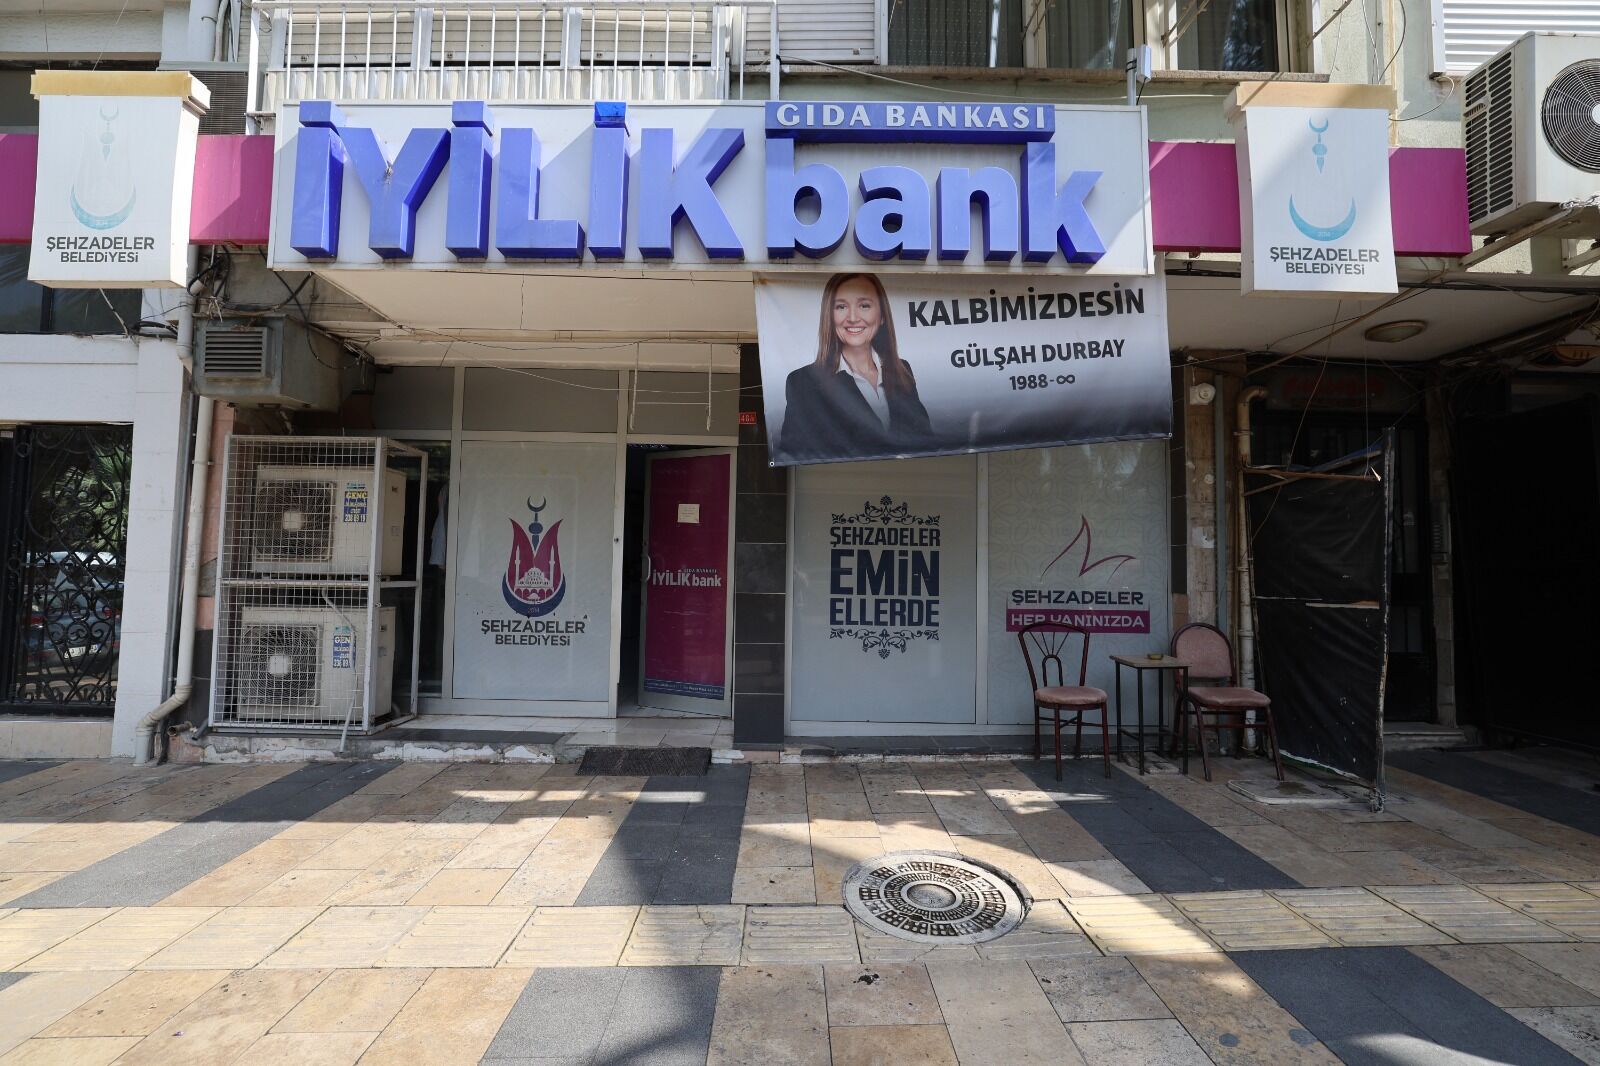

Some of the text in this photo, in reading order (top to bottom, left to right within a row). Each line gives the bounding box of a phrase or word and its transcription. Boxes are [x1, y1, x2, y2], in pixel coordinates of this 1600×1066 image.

[776, 103, 1046, 129] GIDA BANKASI
[290, 101, 1106, 265] İYİLİK bank
[46, 236, 155, 252] ŞEHZADELER
[1269, 246, 1380, 263] ŞEHZADELER
[908, 282, 1145, 328] KALBİMİZDESİN
[950, 338, 1126, 371] GÜLŞAH DURBAY
[829, 526, 941, 548] ŞEHZADELER
[692, 574, 722, 587] bank
[1011, 589, 1144, 606] ŞEHZADELER
[829, 597, 940, 627] ELLERDE
[481, 619, 586, 635] ŞEHZADELER
